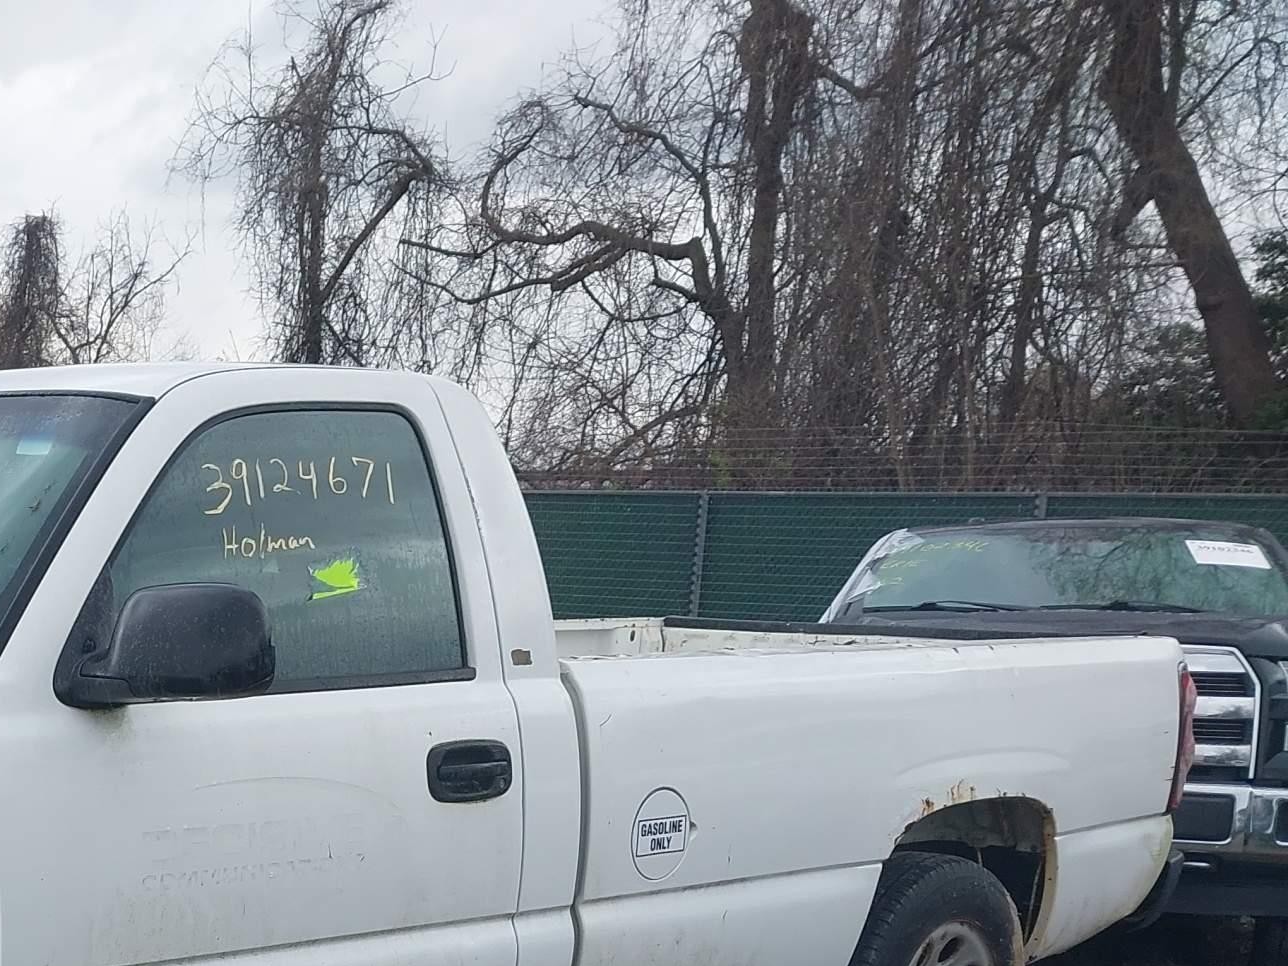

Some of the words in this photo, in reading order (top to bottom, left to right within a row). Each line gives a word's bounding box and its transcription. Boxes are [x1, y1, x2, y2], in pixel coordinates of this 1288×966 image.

[200, 456, 395, 515] 39124671
[222, 523, 316, 559] Holman
[640, 819, 683, 838] GASOLINE
[649, 835, 673, 852] ONLY
